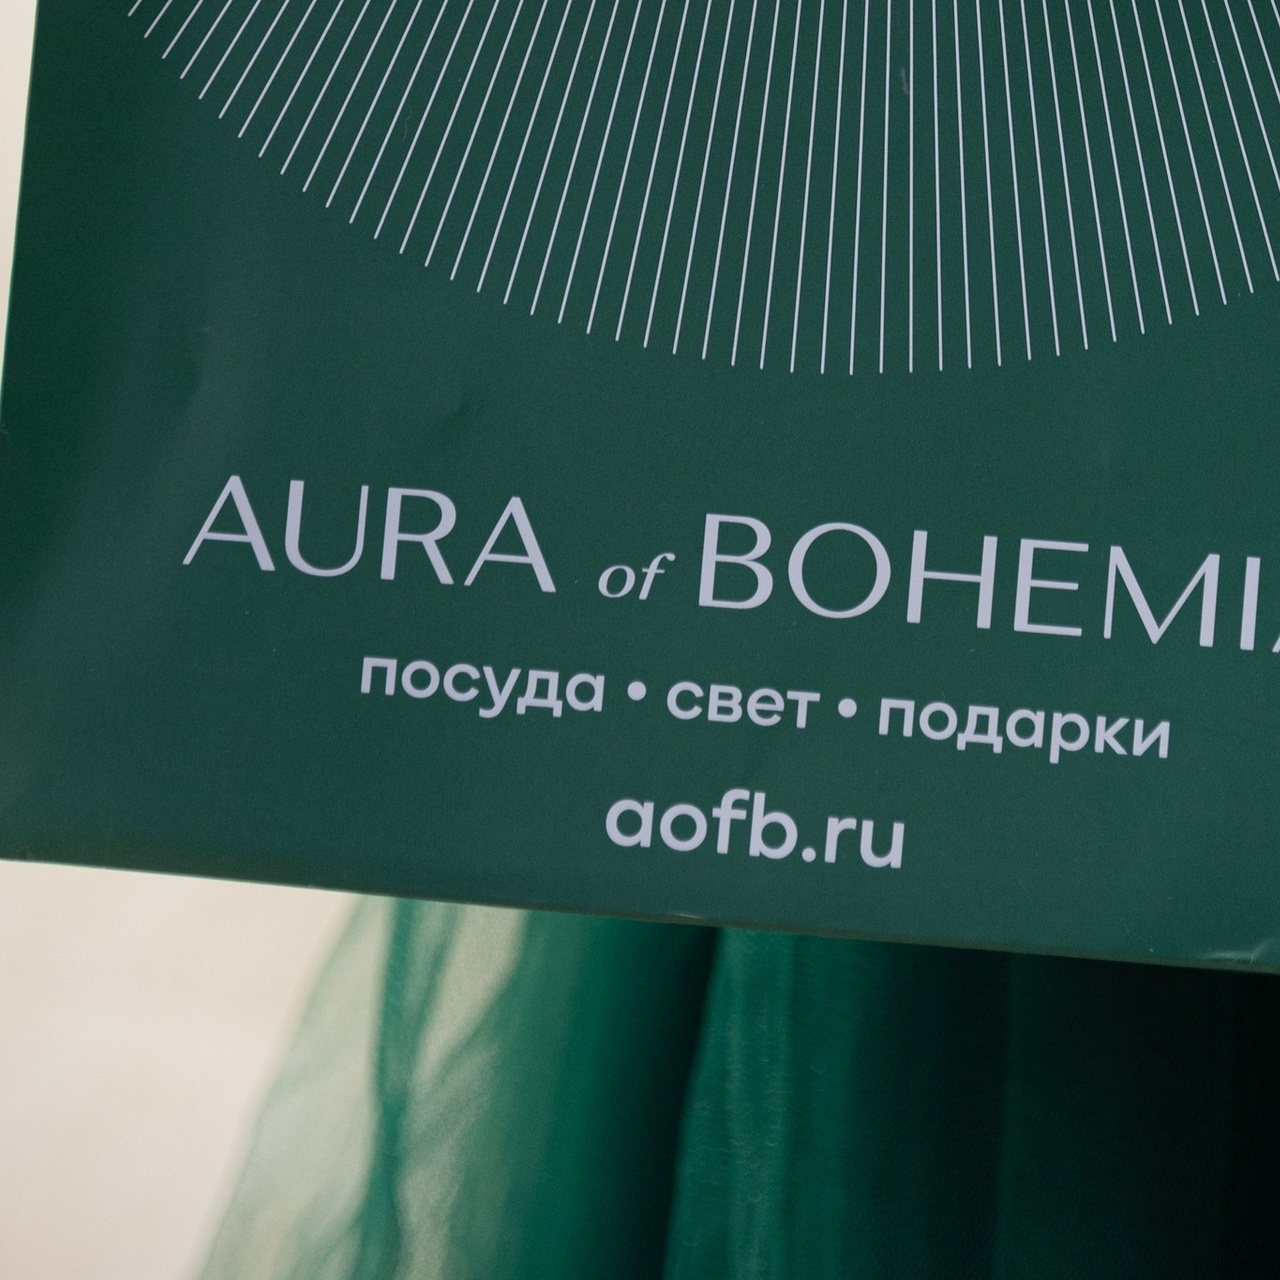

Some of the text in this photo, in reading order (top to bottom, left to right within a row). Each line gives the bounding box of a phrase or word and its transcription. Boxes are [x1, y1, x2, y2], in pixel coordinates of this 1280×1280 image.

[182, 475, 556, 593] AURA
[598, 551, 677, 601] of
[360, 656, 1171, 764] посуда свет подарки
[605, 787, 905, 869] aofb.ru
